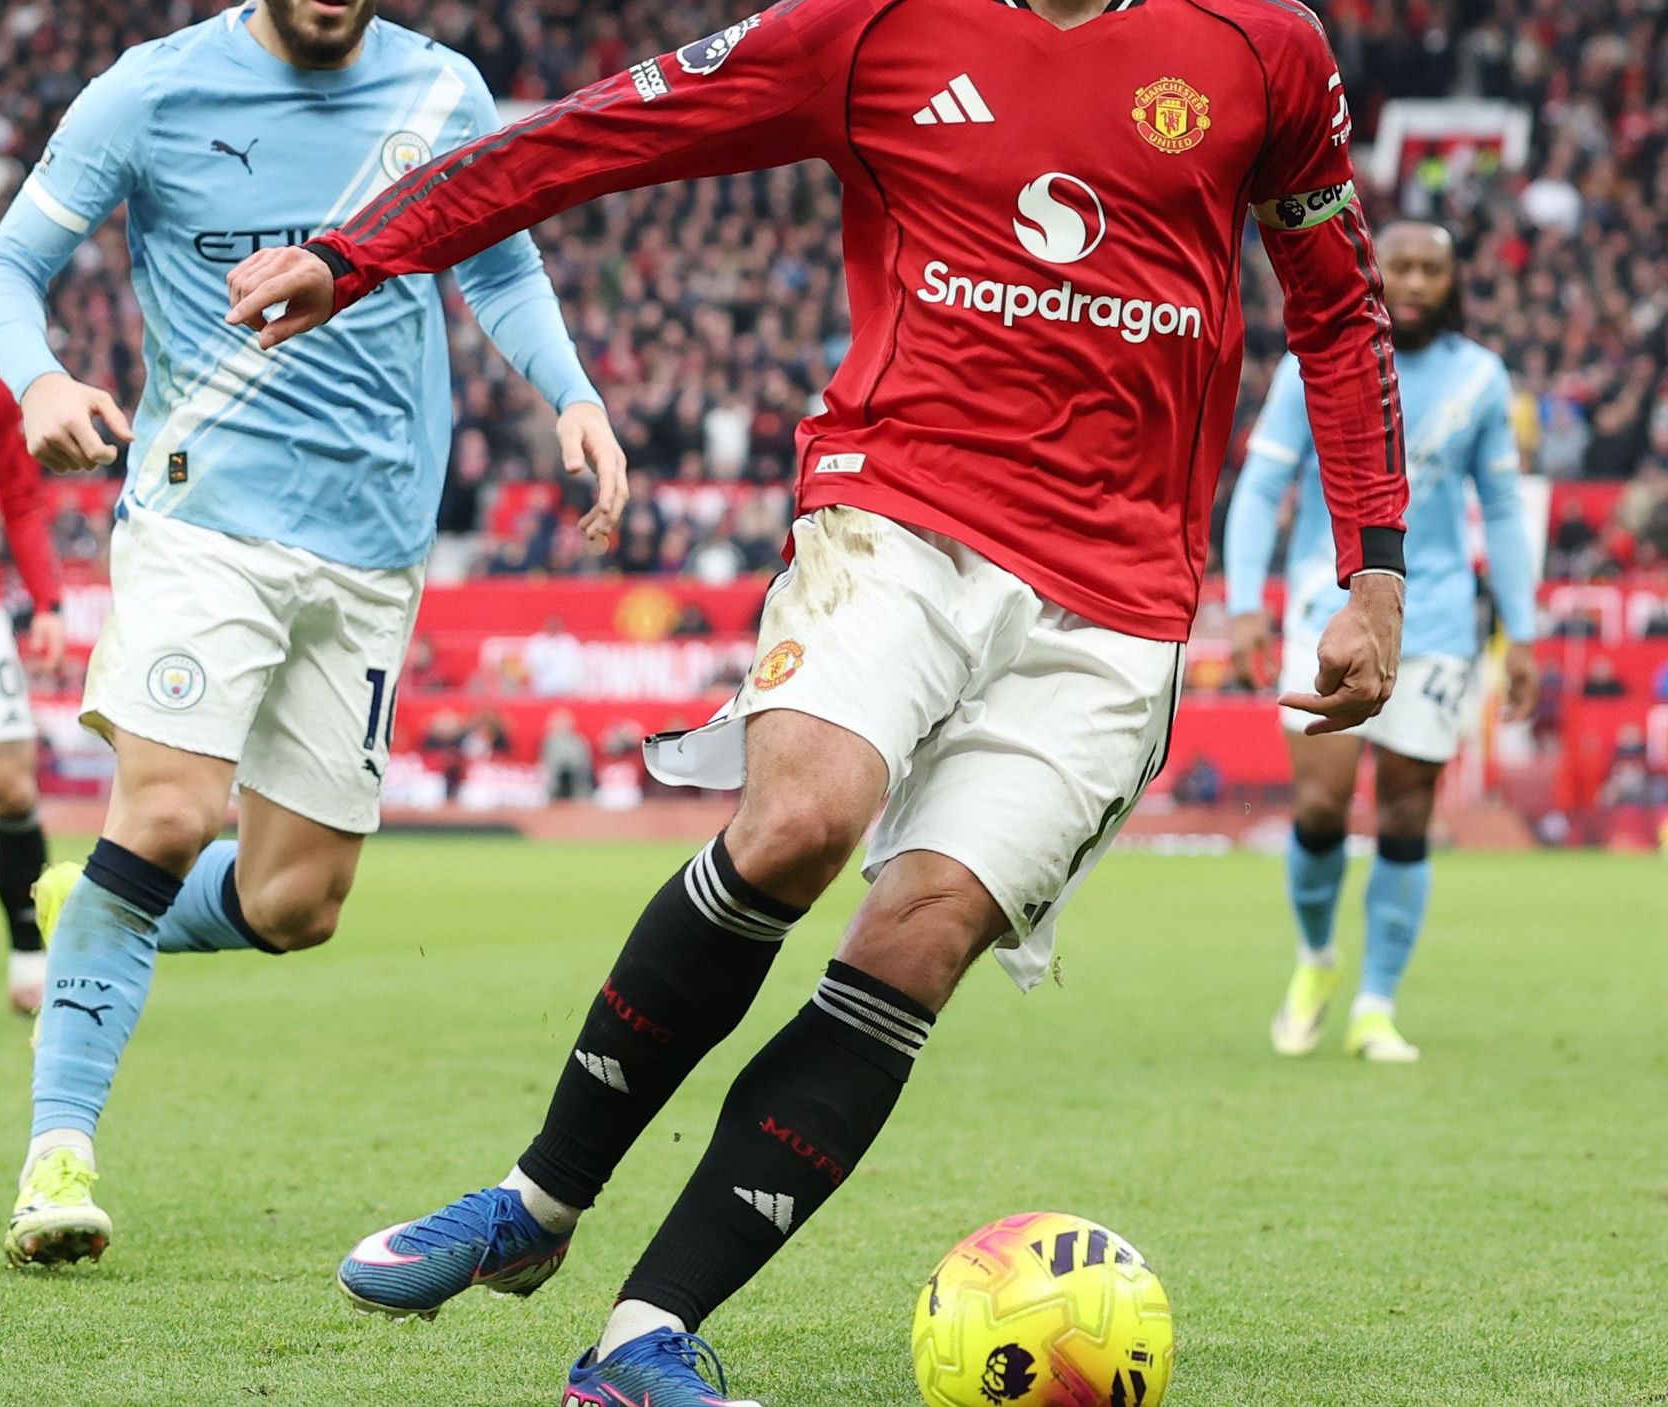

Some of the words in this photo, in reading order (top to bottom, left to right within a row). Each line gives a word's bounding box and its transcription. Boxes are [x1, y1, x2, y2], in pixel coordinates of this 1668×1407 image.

[1140, 82, 1204, 111] MANCHESTER
[1148, 132, 1193, 149] UNITED
[916, 260, 1202, 343] Snapdragon
[363, 667, 397, 752] 1
